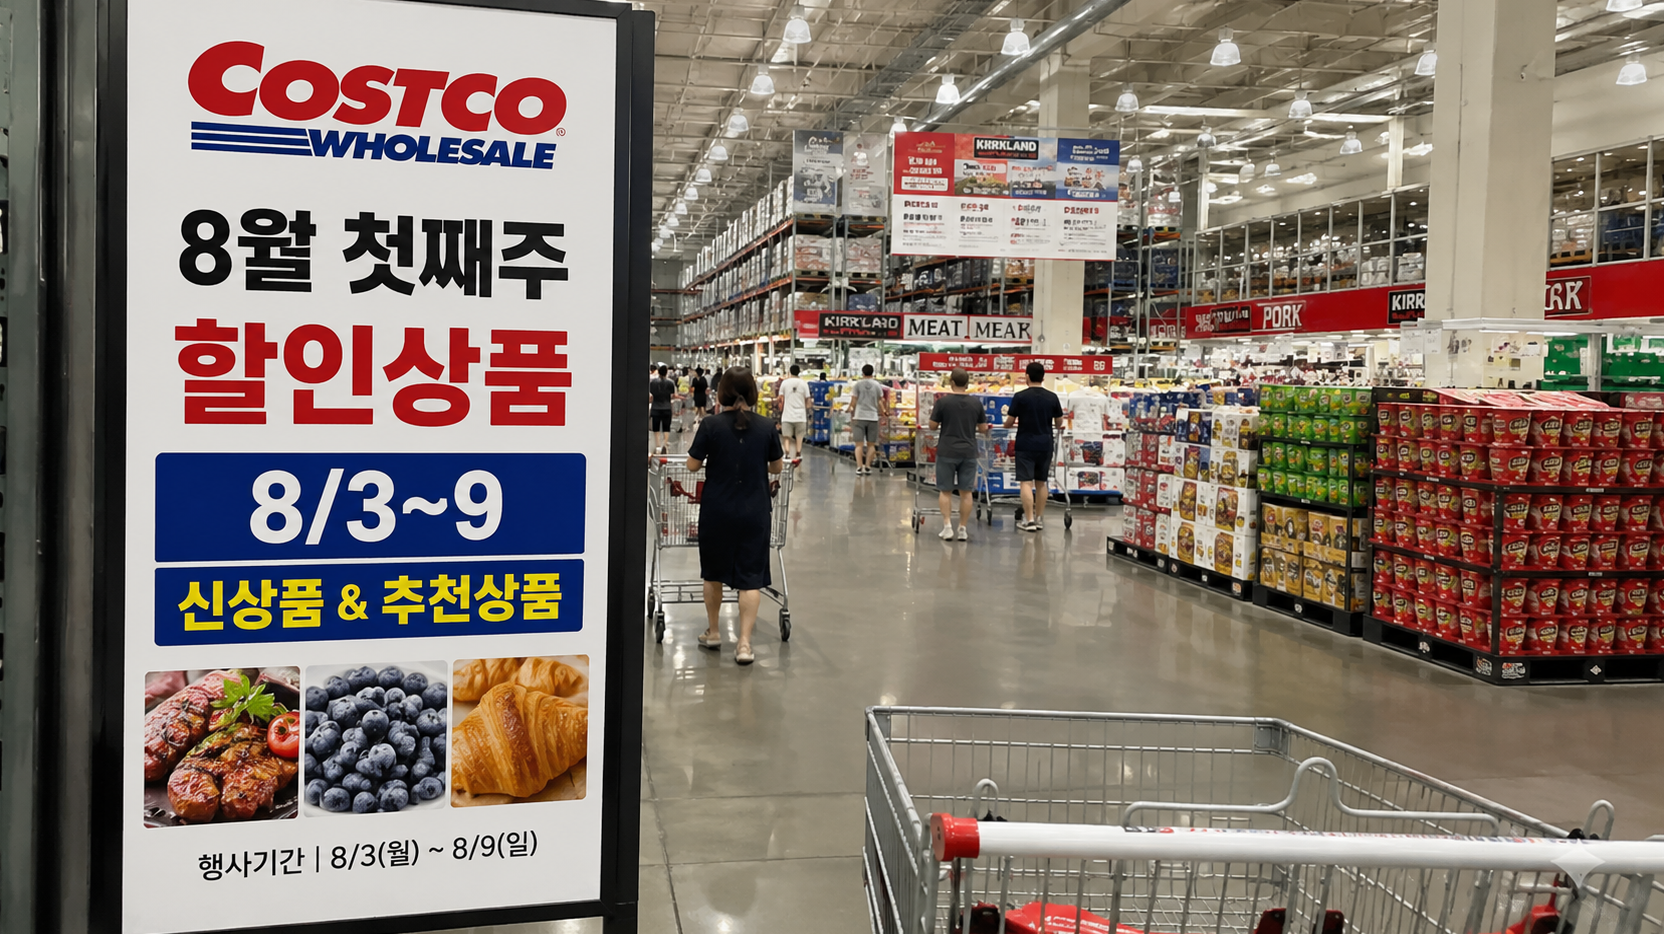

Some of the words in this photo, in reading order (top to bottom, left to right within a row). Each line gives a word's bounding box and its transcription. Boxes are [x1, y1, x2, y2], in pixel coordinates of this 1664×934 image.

[187, 40, 567, 136] COSTCO
[308, 129, 557, 169] WHOLESALE
[178, 208, 317, 293] 8월
[342, 211, 569, 300] 첫째주
[908, 319, 963, 337] MEAT
[1263, 304, 1303, 329] PORK
[174, 317, 573, 428] 할인상품
[249, 468, 503, 546] 8/3~9
[177, 578, 324, 632] 신상품
[337, 583, 369, 621] &
[381, 572, 562, 625] 추천상품
[198, 847, 306, 881] 행사기간
[330, 839, 420, 871] 8/3(월)
[452, 830, 538, 861] 8/9(일)
